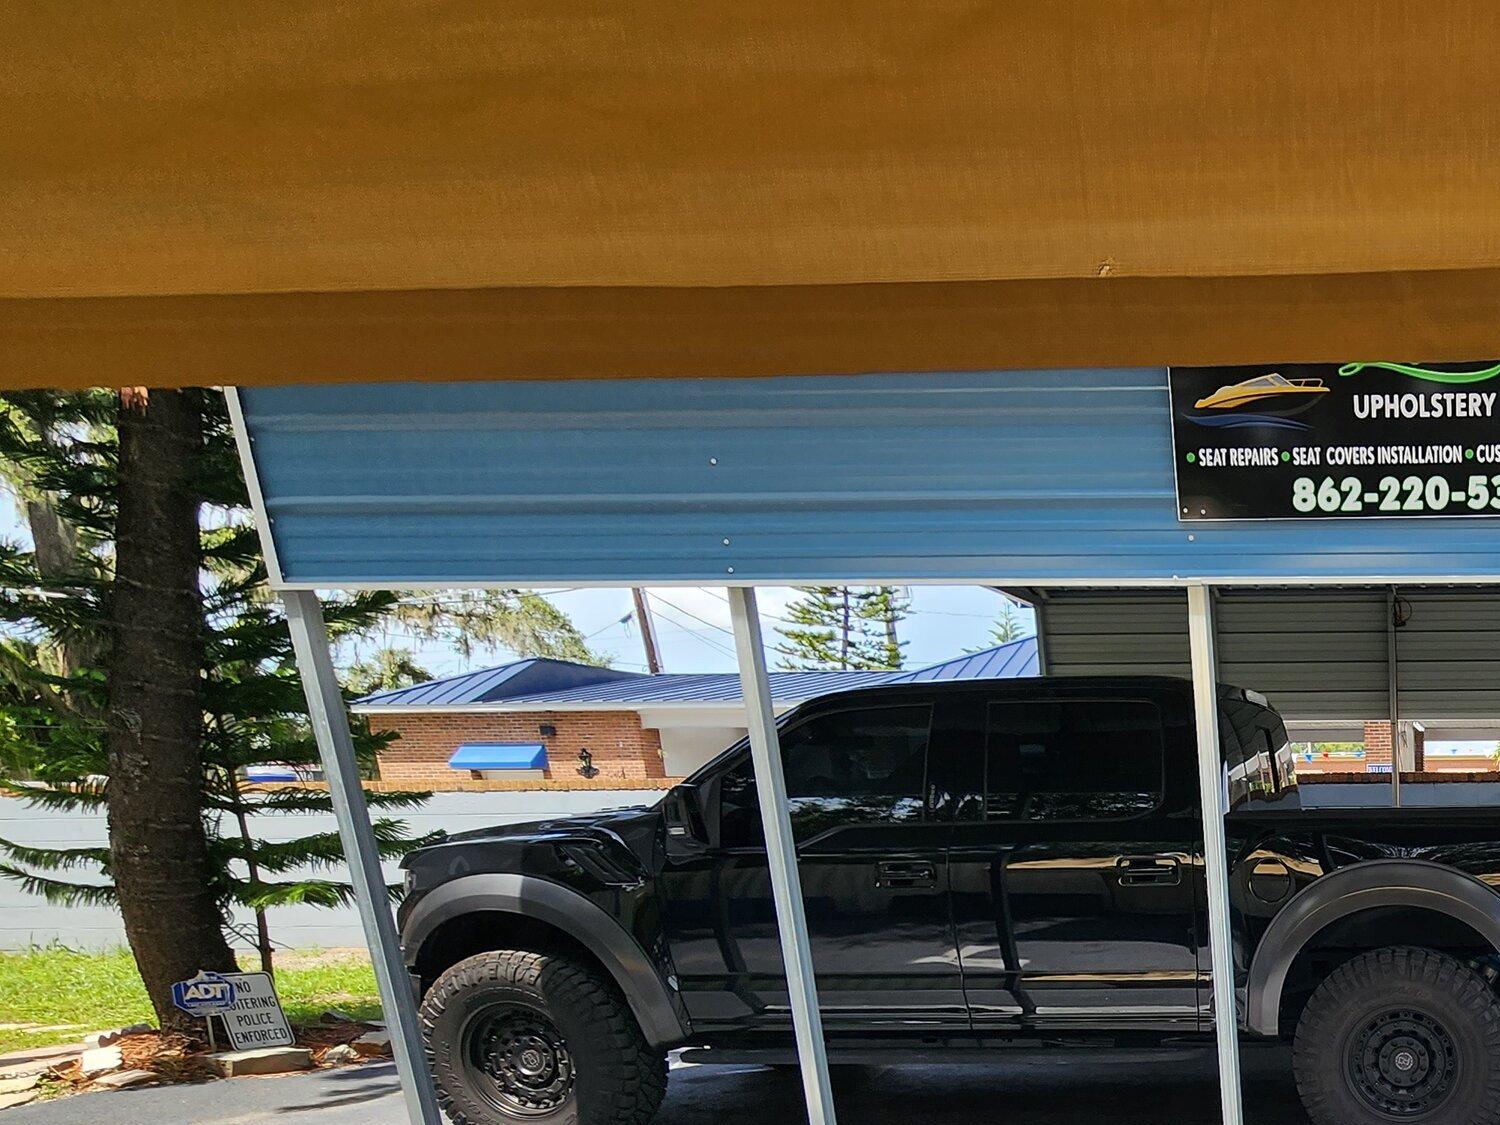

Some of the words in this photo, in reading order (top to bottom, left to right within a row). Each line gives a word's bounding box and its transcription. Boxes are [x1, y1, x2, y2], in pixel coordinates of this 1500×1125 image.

[1353, 392, 1497, 419] UPHOLSTERY
[1198, 448, 1227, 467] SEAT
[1229, 447, 1279, 466] REPAIRS
[1292, 446, 1321, 466] SEAT
[1326, 446, 1376, 465] COVERS
[1377, 444, 1463, 465] INSTALLATION
[184, 983, 231, 1001] ADT
[236, 981, 251, 993] NO
[228, 995, 276, 1012] OITERING
[236, 1012, 275, 1027] POLICE
[234, 1027, 288, 1044] ENFORCED
